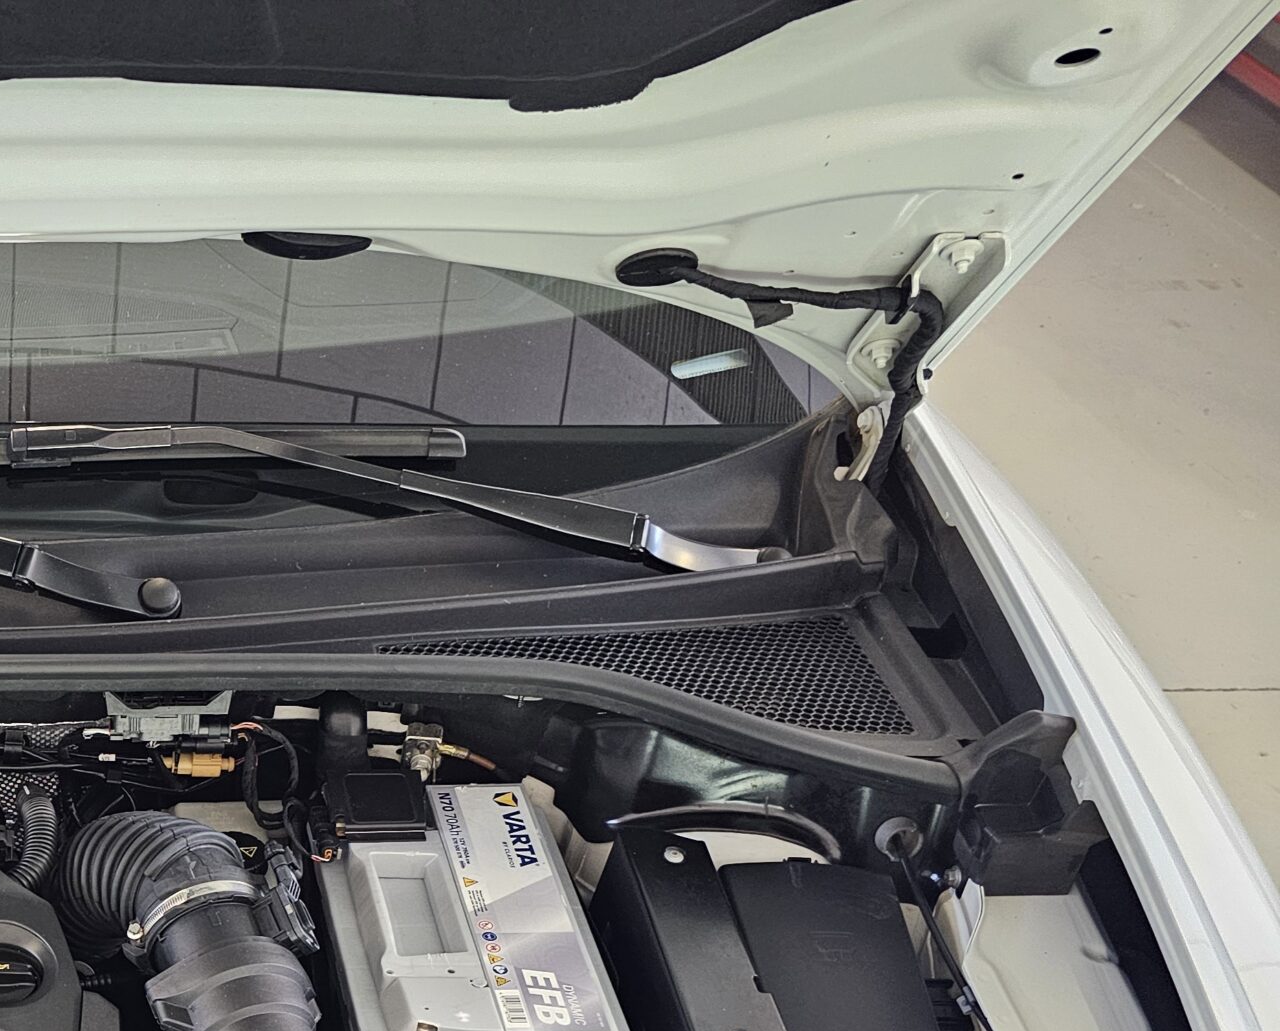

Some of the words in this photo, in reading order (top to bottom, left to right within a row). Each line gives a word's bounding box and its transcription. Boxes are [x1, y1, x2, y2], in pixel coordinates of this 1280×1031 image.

[438, 792, 455, 812] N70
[444, 813, 461, 836] 70Ah
[502, 811, 539, 867] VARTA
[522, 968, 571, 1026] EFB
[562, 984, 586, 1026] DYNAMIC
